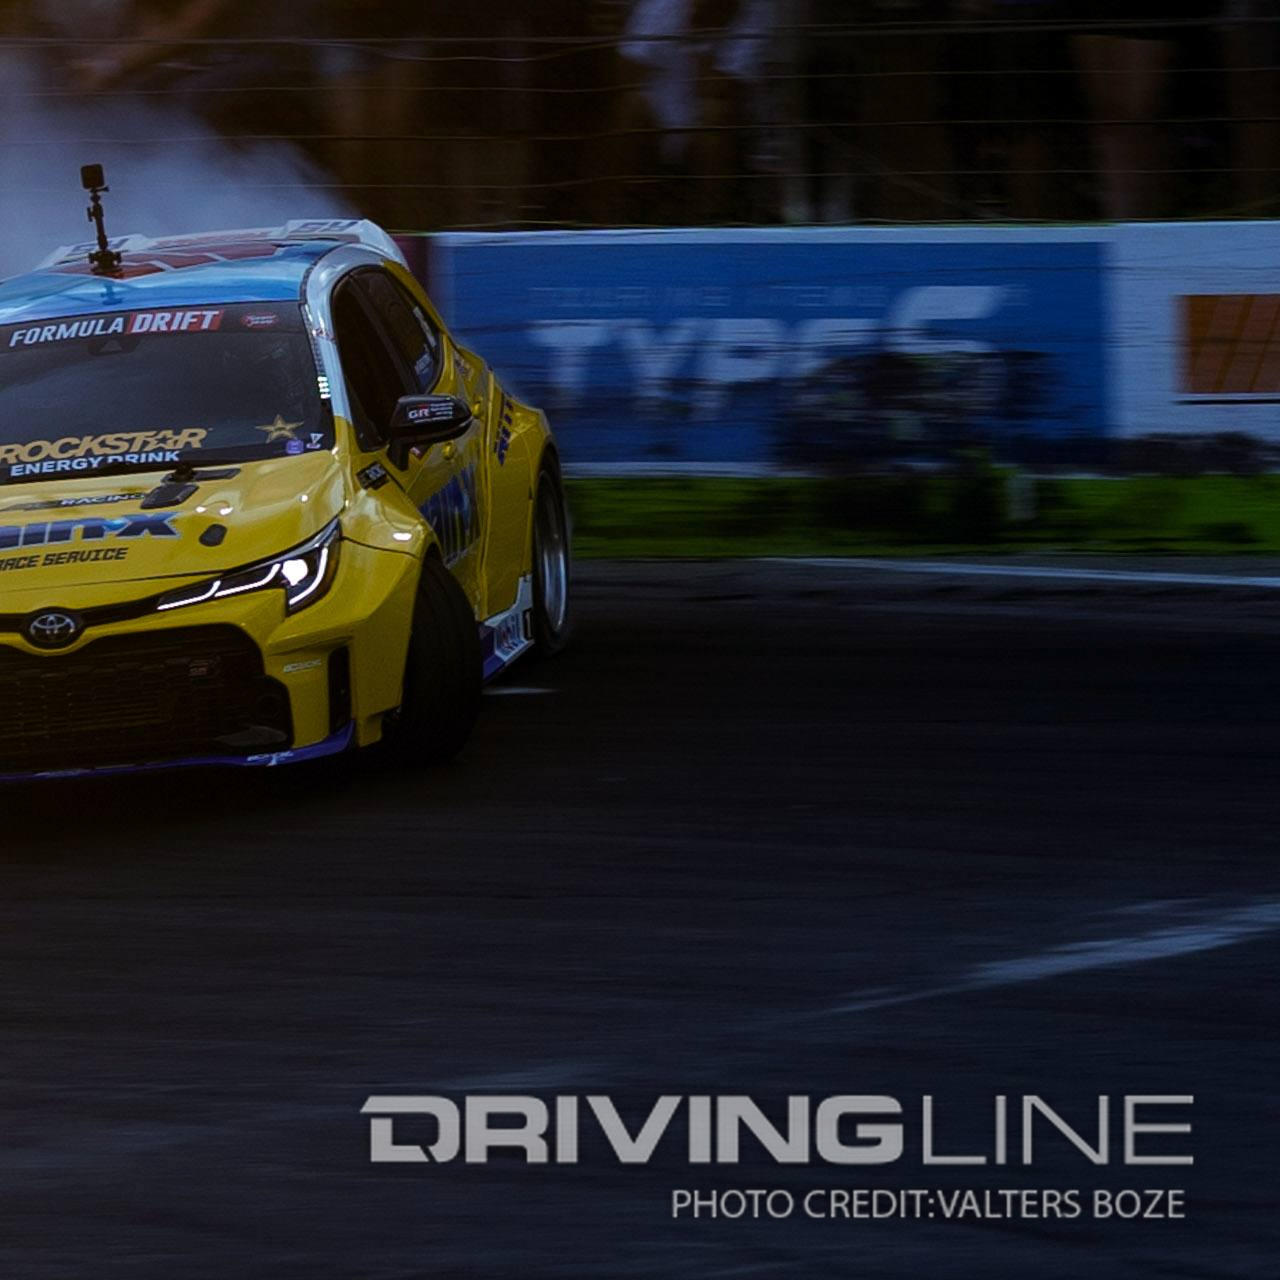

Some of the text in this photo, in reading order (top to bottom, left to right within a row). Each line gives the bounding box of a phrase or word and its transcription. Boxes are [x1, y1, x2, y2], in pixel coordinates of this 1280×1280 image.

[8, 318, 124, 348] FORMULA
[130, 309, 220, 333] DRIFT
[10, 450, 181, 477] ENERGY DRINK
[42, 547, 129, 567] SERVICE
